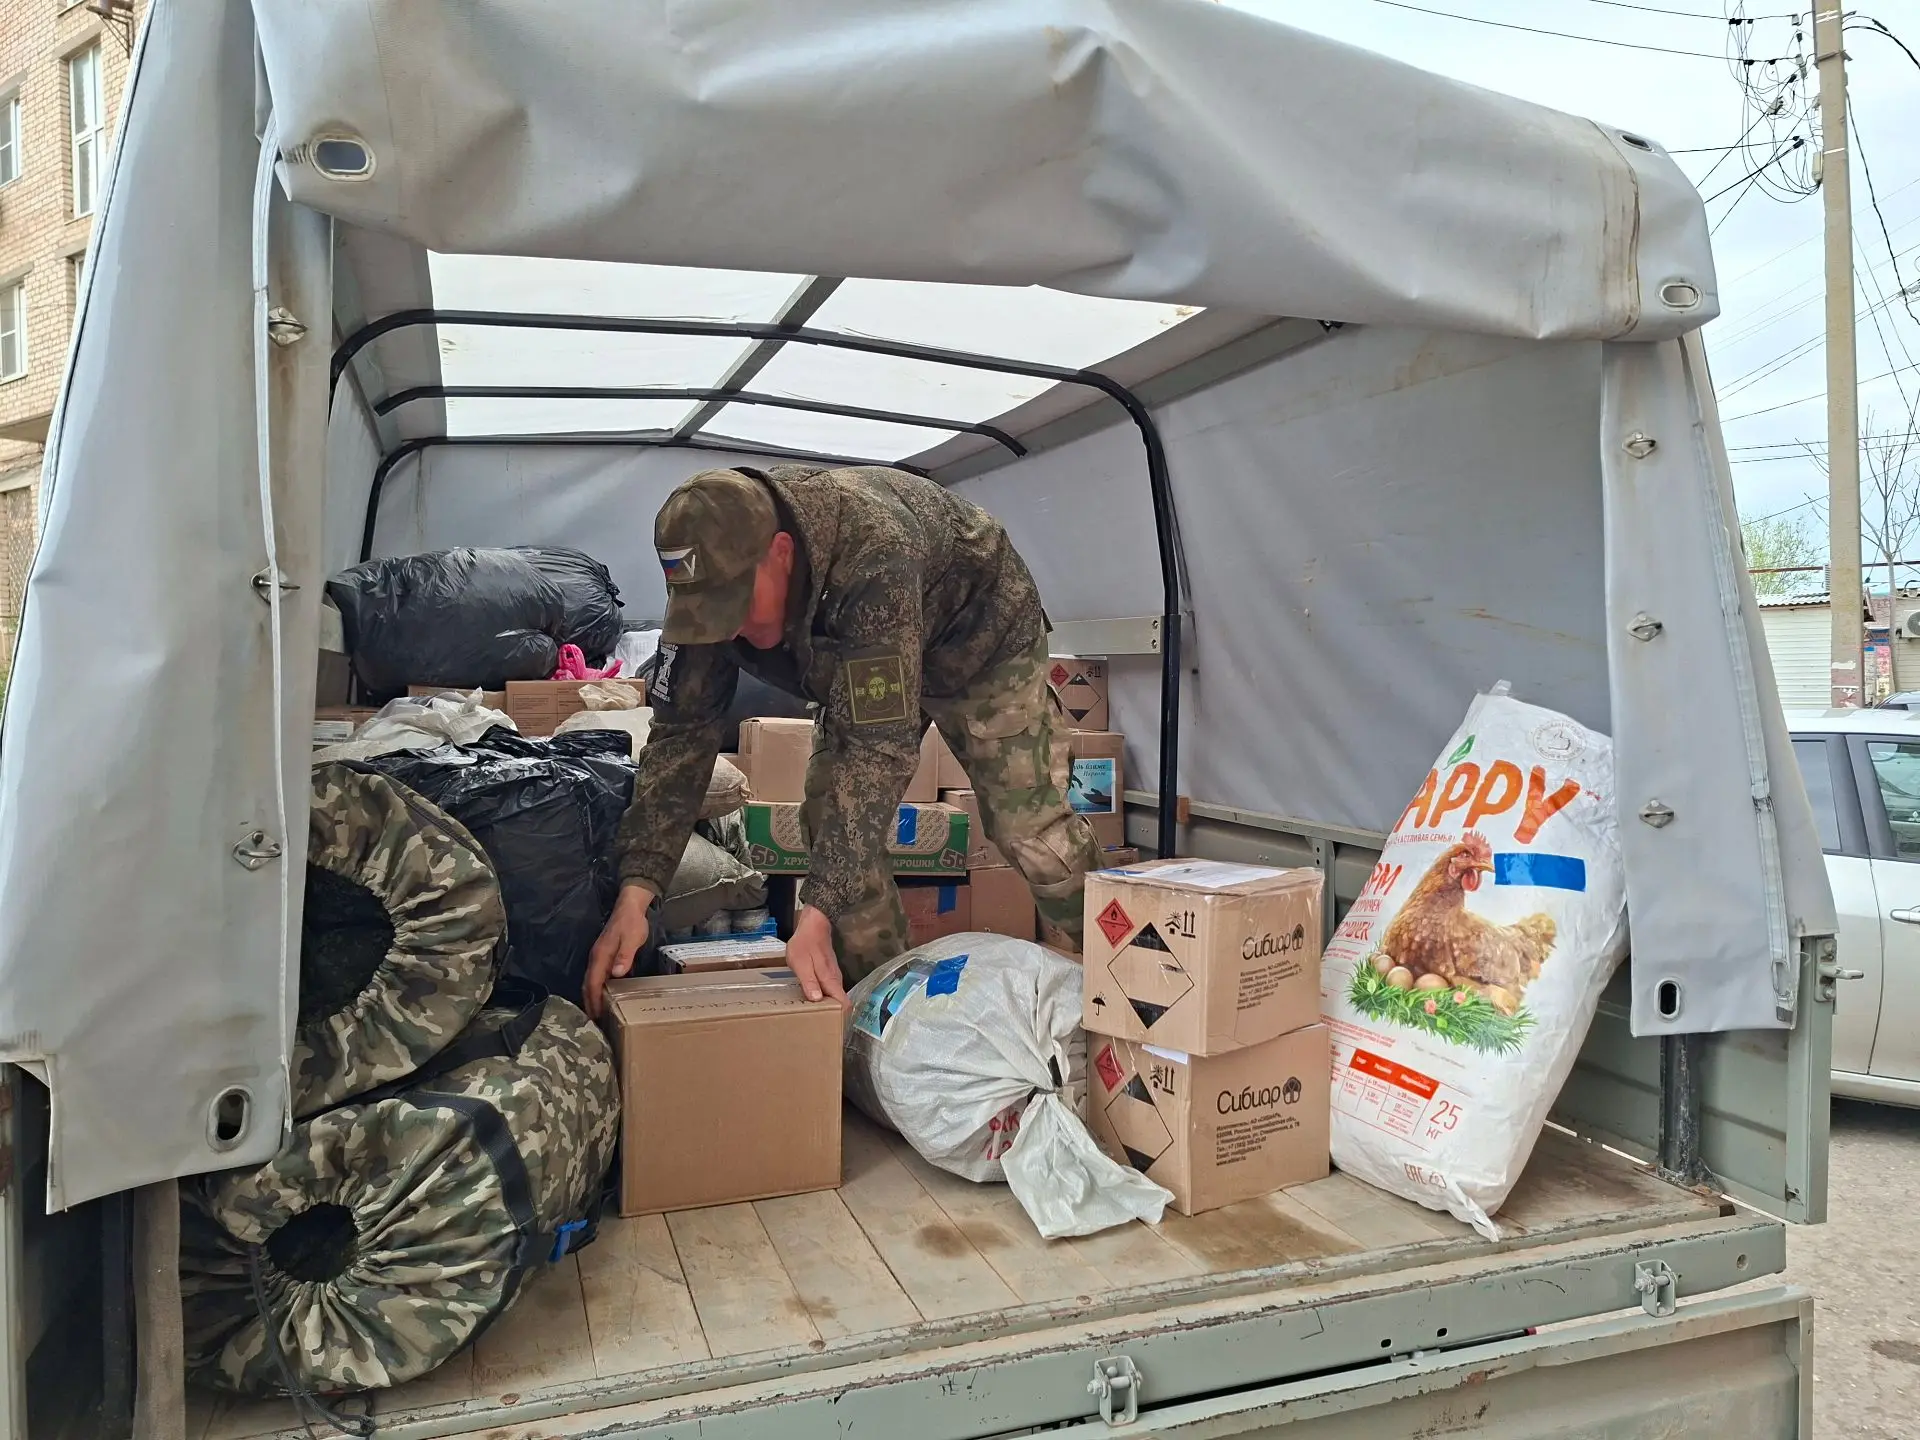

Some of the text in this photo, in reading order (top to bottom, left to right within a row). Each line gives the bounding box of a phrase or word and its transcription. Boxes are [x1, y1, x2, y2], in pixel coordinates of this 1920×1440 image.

[1393, 759, 1581, 844] APPY
[784, 856, 810, 866] ХРУС
[1242, 932, 1291, 961] Сибиар
[1216, 1085, 1281, 1115] Сибиар
[1430, 1100, 1463, 1131] 25
